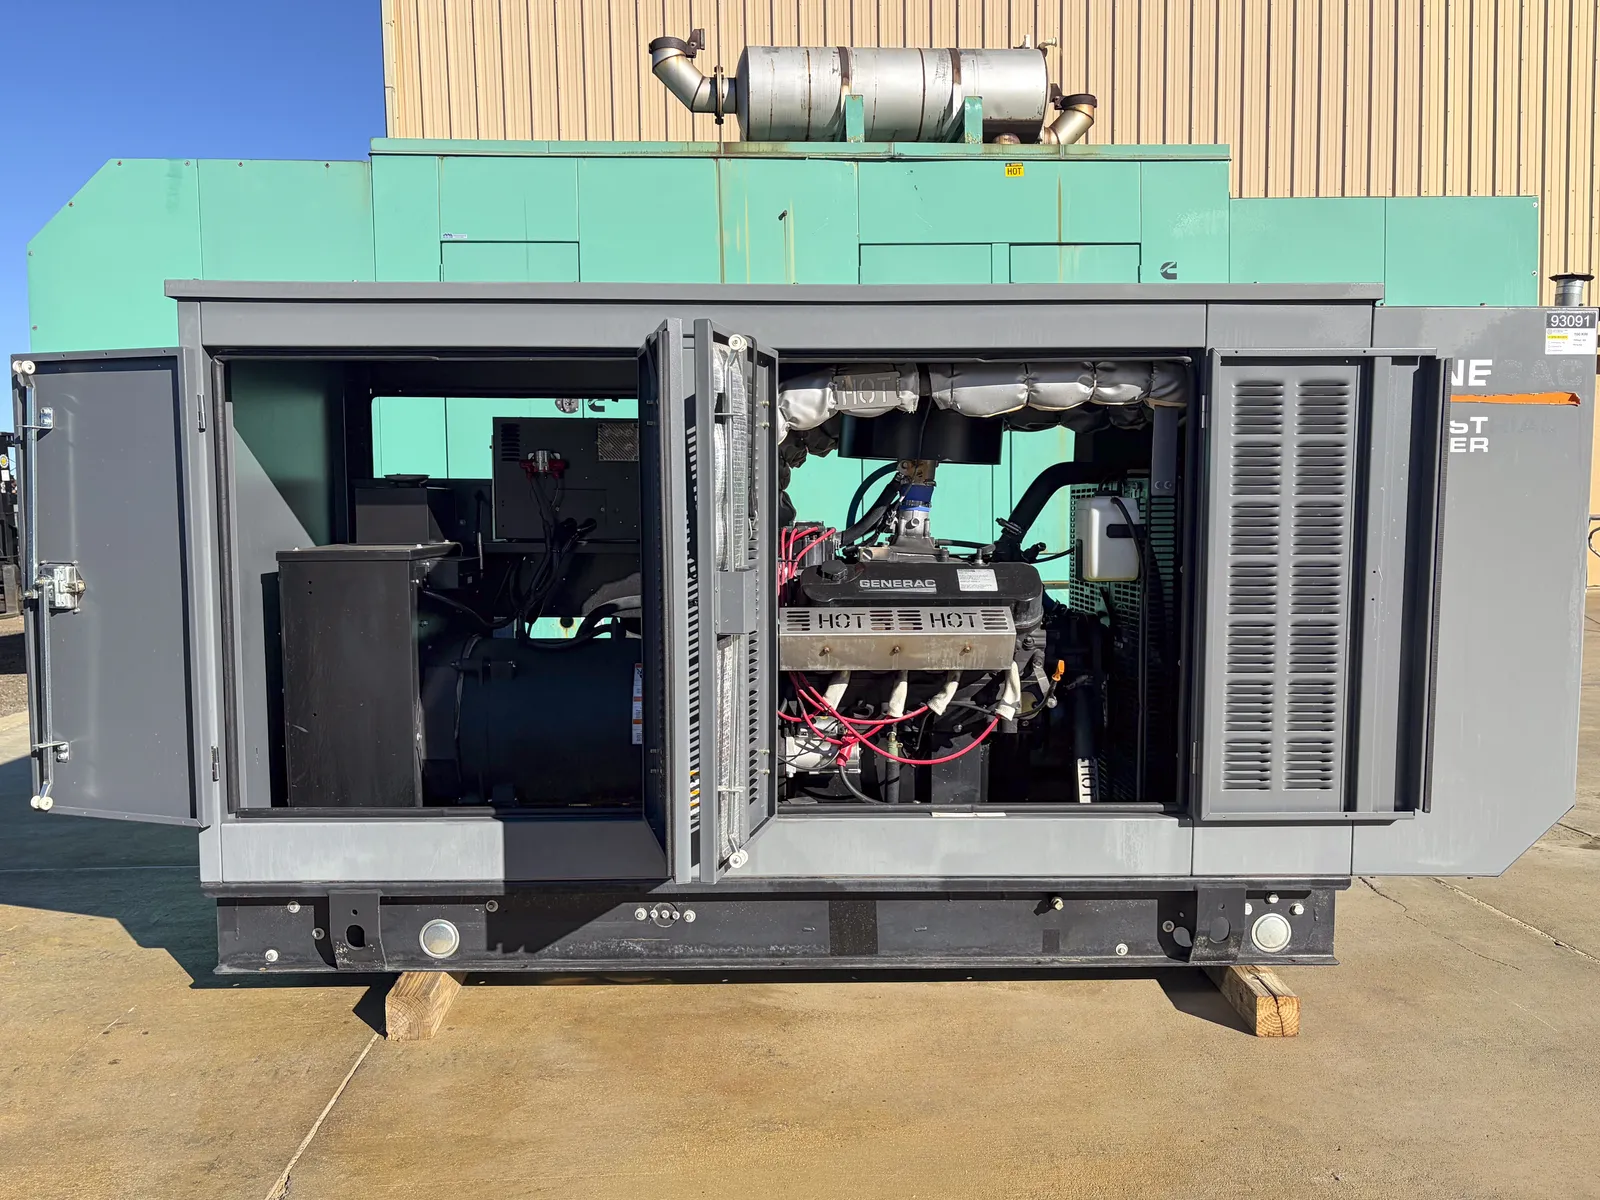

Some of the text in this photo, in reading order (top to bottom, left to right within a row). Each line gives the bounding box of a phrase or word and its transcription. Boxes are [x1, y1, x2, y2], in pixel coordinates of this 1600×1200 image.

[1007, 167, 1022, 176] HOT
[1550, 314, 1590, 328] 93091
[841, 375, 892, 406] HOT
[859, 579, 936, 589] GENERAC
[818, 612, 978, 629] HOT HOT
